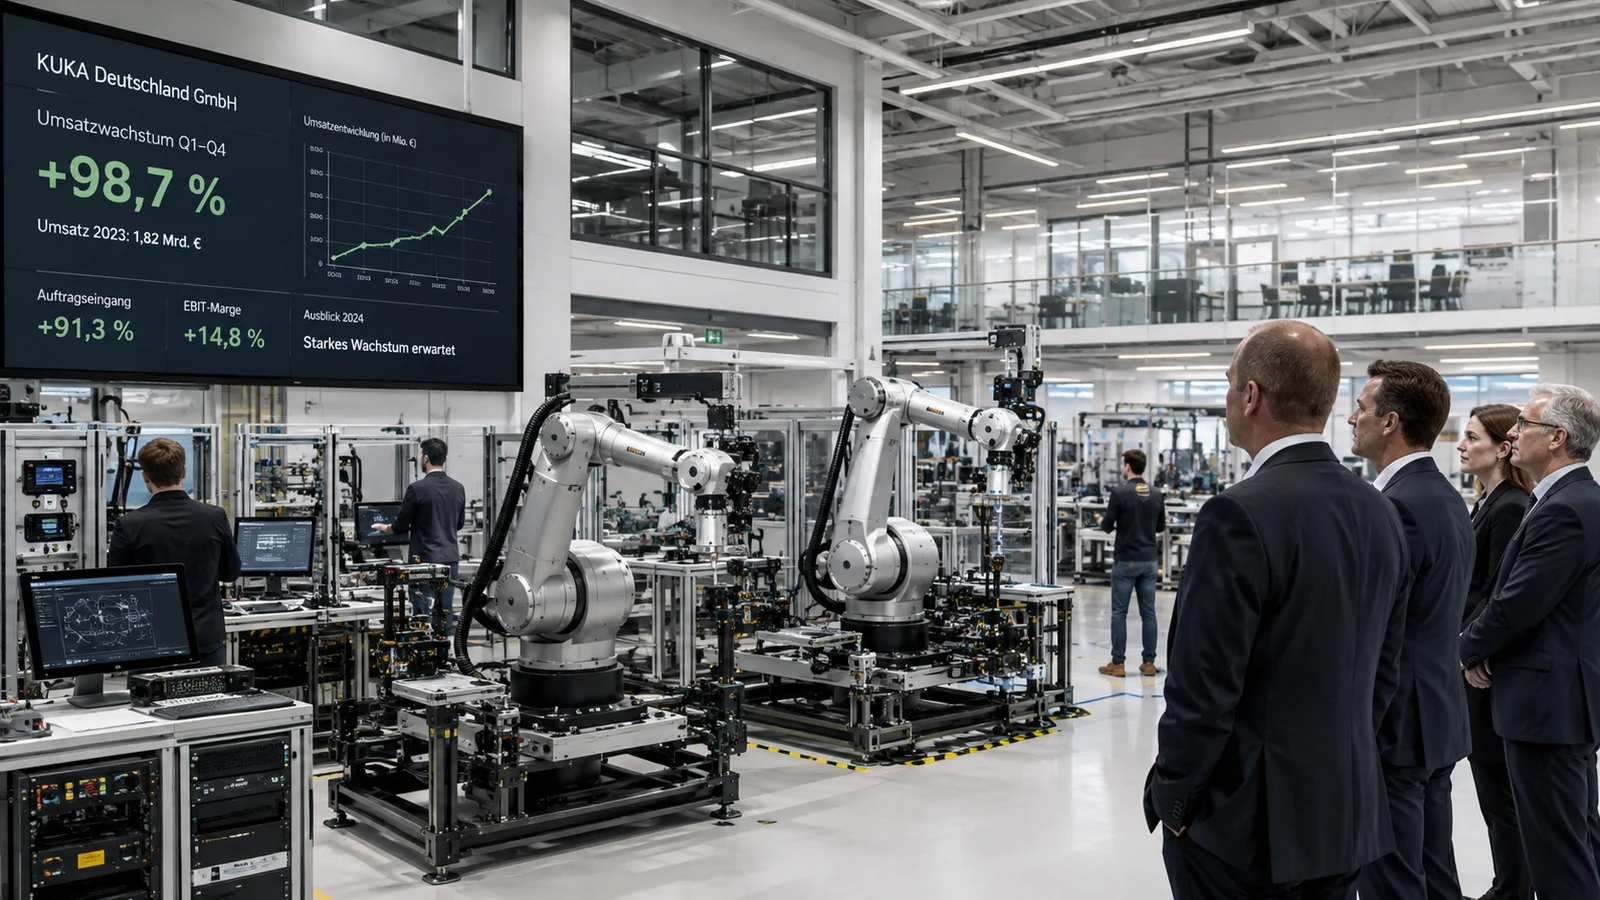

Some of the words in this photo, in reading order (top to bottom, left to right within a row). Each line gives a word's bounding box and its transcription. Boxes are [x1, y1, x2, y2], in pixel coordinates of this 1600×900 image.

[38, 52, 90, 80] KUKA
[95, 65, 190, 101] Deutschland
[193, 88, 237, 111] GmbH
[37, 109, 174, 148] Umsatzwachstum
[38, 155, 173, 213] +98,7
[188, 173, 226, 216] %
[37, 218, 90, 238] Umsatz
[93, 225, 130, 242] 2023:
[133, 230, 159, 246] 1,82
[162, 233, 190, 249] Mrd.
[193, 237, 202, 250] €
[37, 288, 132, 309] Auftragseingang
[184, 300, 242, 317] EBIT-Marge
[303, 309, 341, 322] Ausblick
[342, 312, 364, 323] 2024
[38, 316, 106, 342] +91,3
[113, 320, 134, 341] %
[184, 325, 242, 350] +14,8
[247, 328, 265, 348] %
[303, 335, 348, 350] Starkes
[350, 338, 409, 353] Wachstum
[411, 344, 456, 355] erwartet
